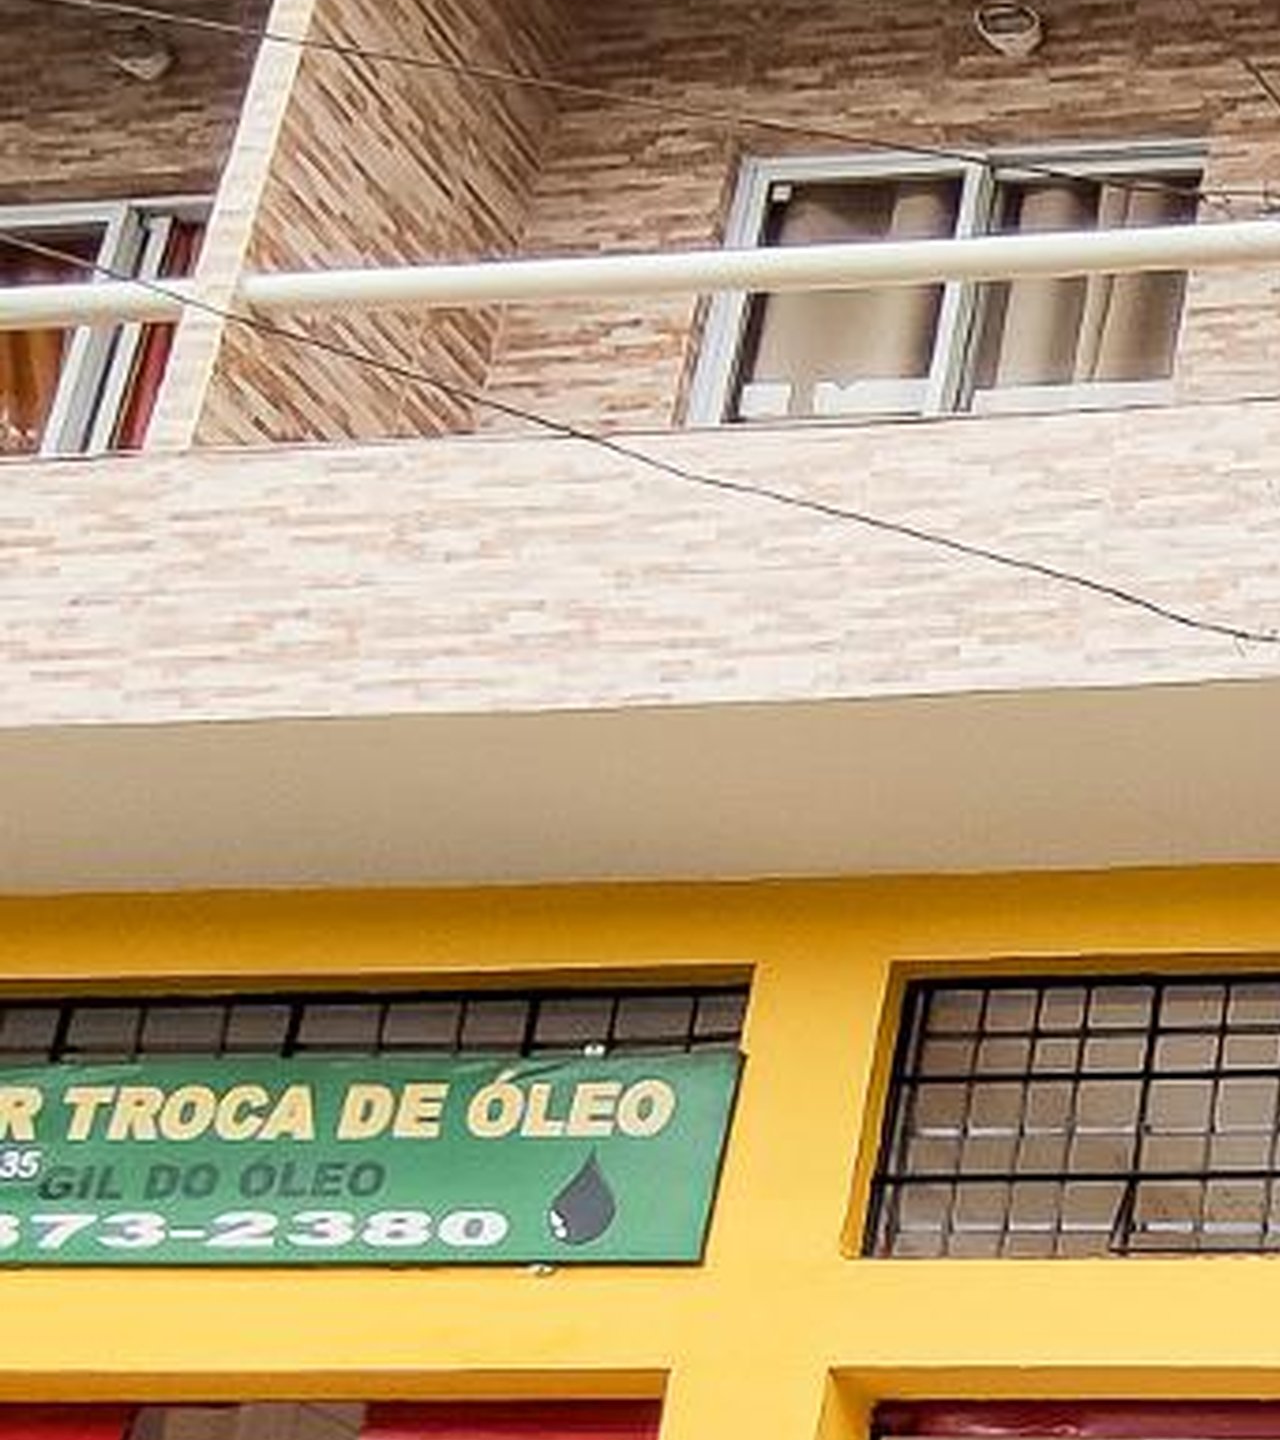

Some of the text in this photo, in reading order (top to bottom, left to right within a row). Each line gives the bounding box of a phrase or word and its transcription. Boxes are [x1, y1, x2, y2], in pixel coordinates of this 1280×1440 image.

[63, 1084, 315, 1142] TROCA
[337, 1083, 450, 1140] DE
[467, 1067, 678, 1139] ÓLEO
[38, 1164, 124, 1200] GIL
[142, 1161, 220, 1199] DO
